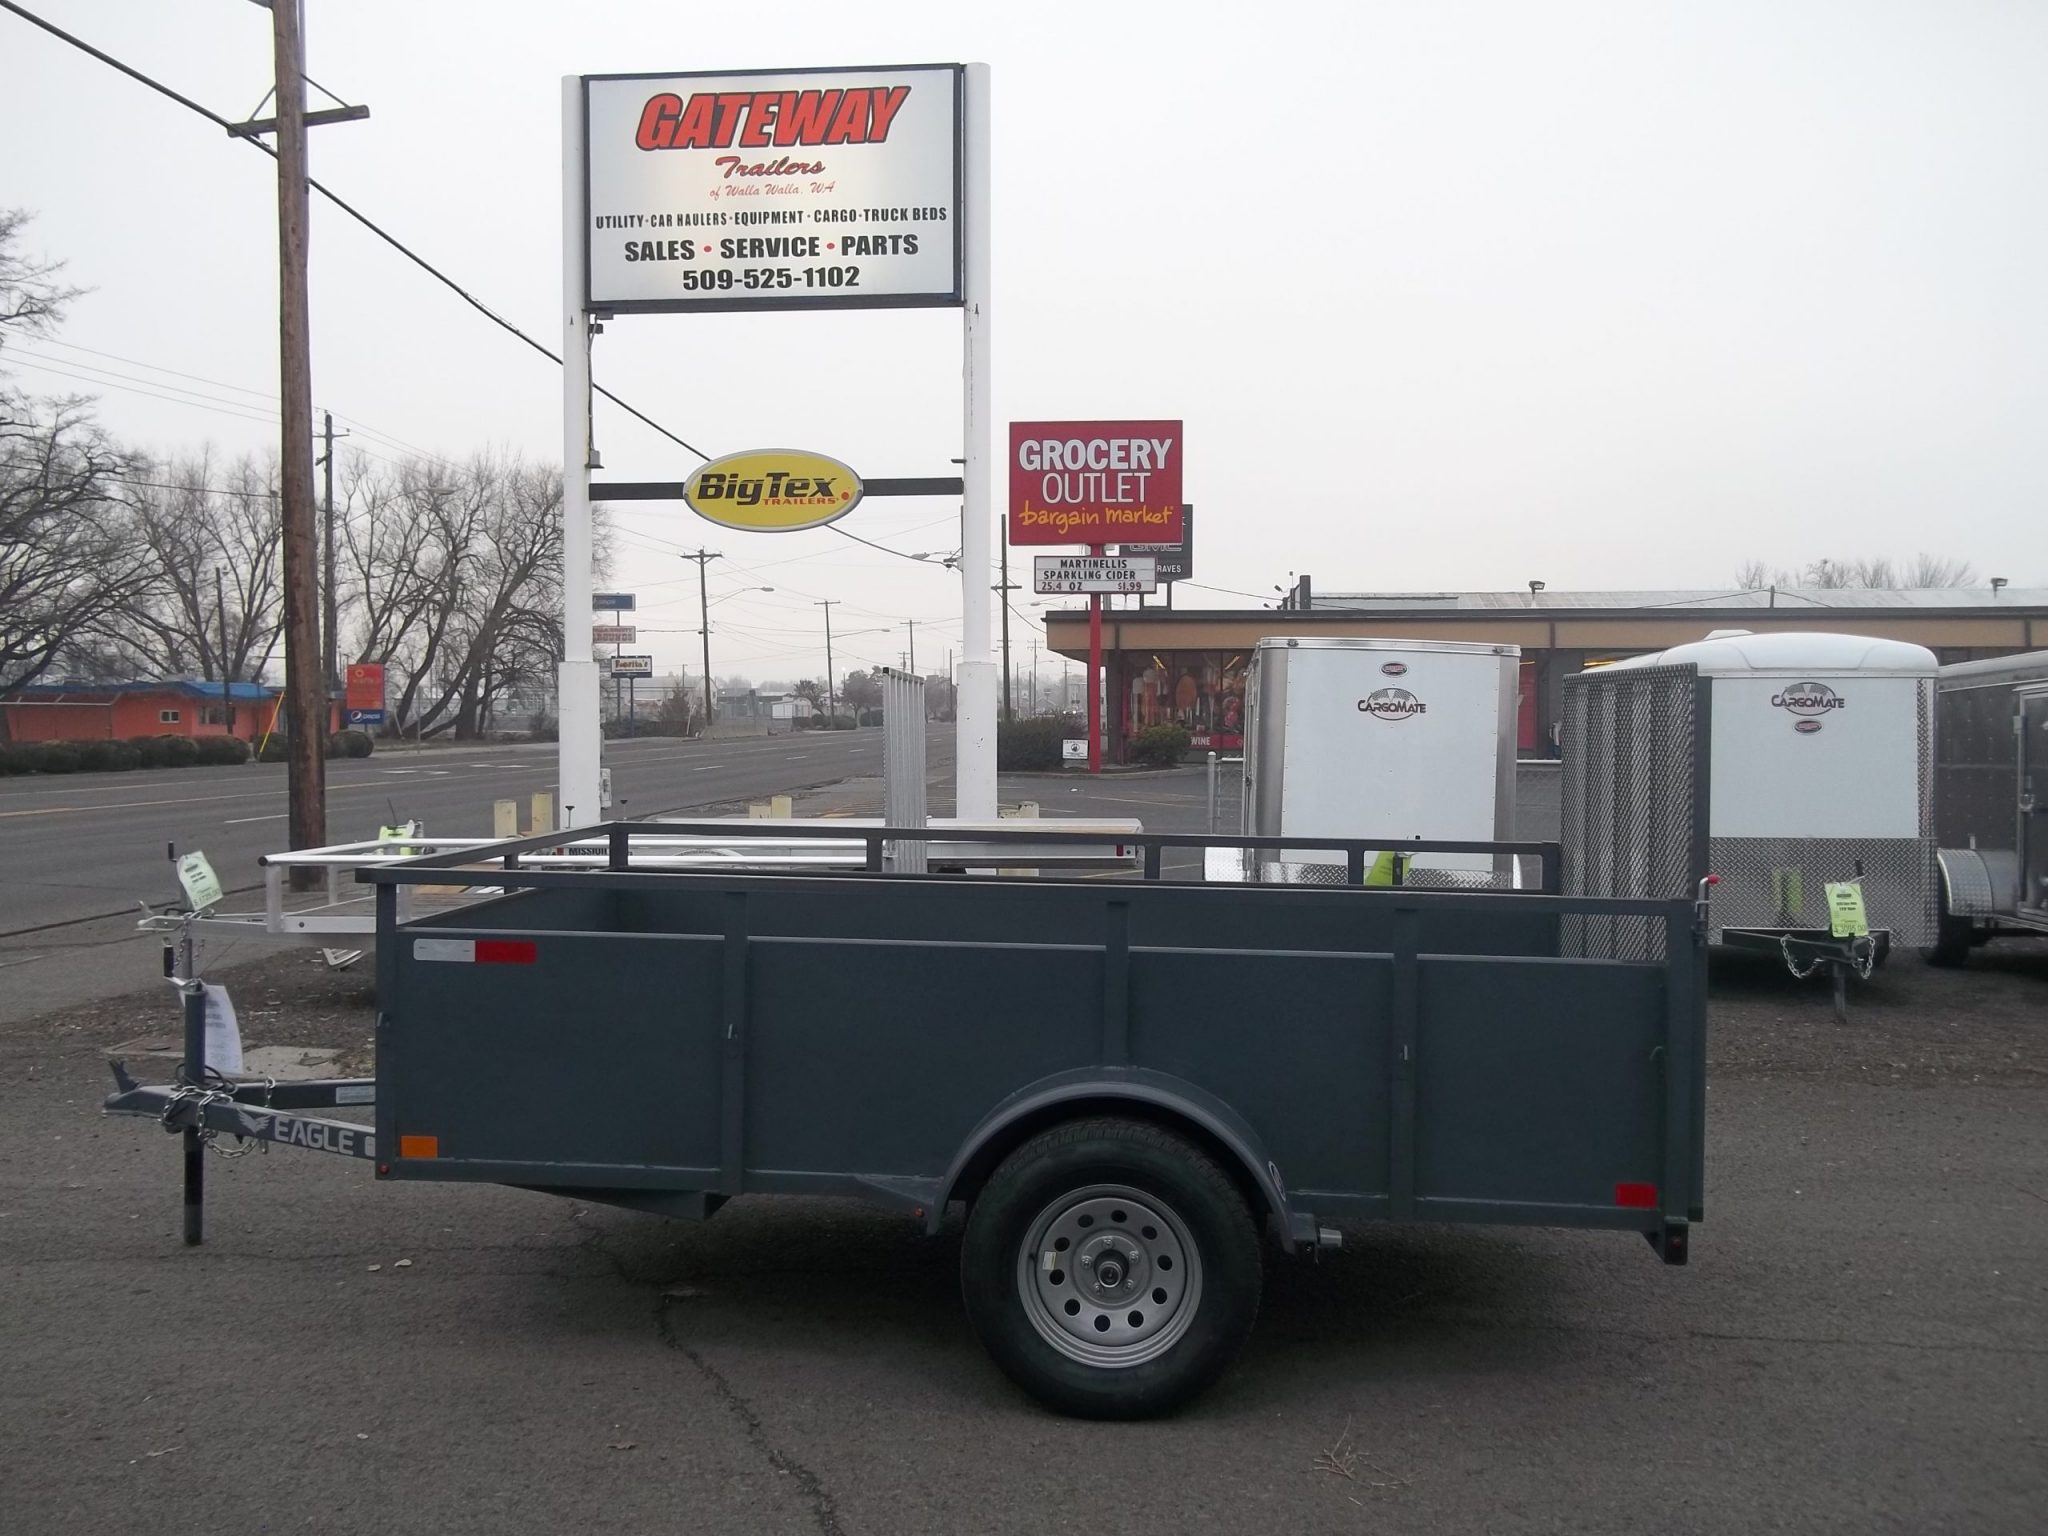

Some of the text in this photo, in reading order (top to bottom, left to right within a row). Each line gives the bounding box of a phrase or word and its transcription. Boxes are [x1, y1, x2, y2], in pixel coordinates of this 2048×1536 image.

[635, 86, 911, 151] GATEWAY
[715, 155, 826, 179] Trailers
[709, 188, 721, 201] of
[725, 183, 760, 197] Walla
[810, 180, 836, 194] WA
[595, 207, 947, 229] UTILITY CAR HAULERS EQUIPMENT CARGO TRUCK BEDS
[624, 234, 919, 262] SALES SERVICE PARTS
[682, 265, 861, 290] 509-525-1102
[1019, 438, 1173, 471] GROCERY
[1042, 472, 1151, 504] OUTLET
[762, 498, 837, 506] TRAILERS
[1018, 500, 1099, 534] bargain
[1105, 505, 1174, 525] market
[1043, 570, 1136, 580] SPARKLING CIDER
[1060, 559, 1128, 569] MARTINELLIS
[1156, 564, 1182, 573] RAVES
[1041, 581, 1083, 591] 25.4 OZ
[1117, 581, 1142, 591] $1.99
[274, 1116, 354, 1155] EAGLE
